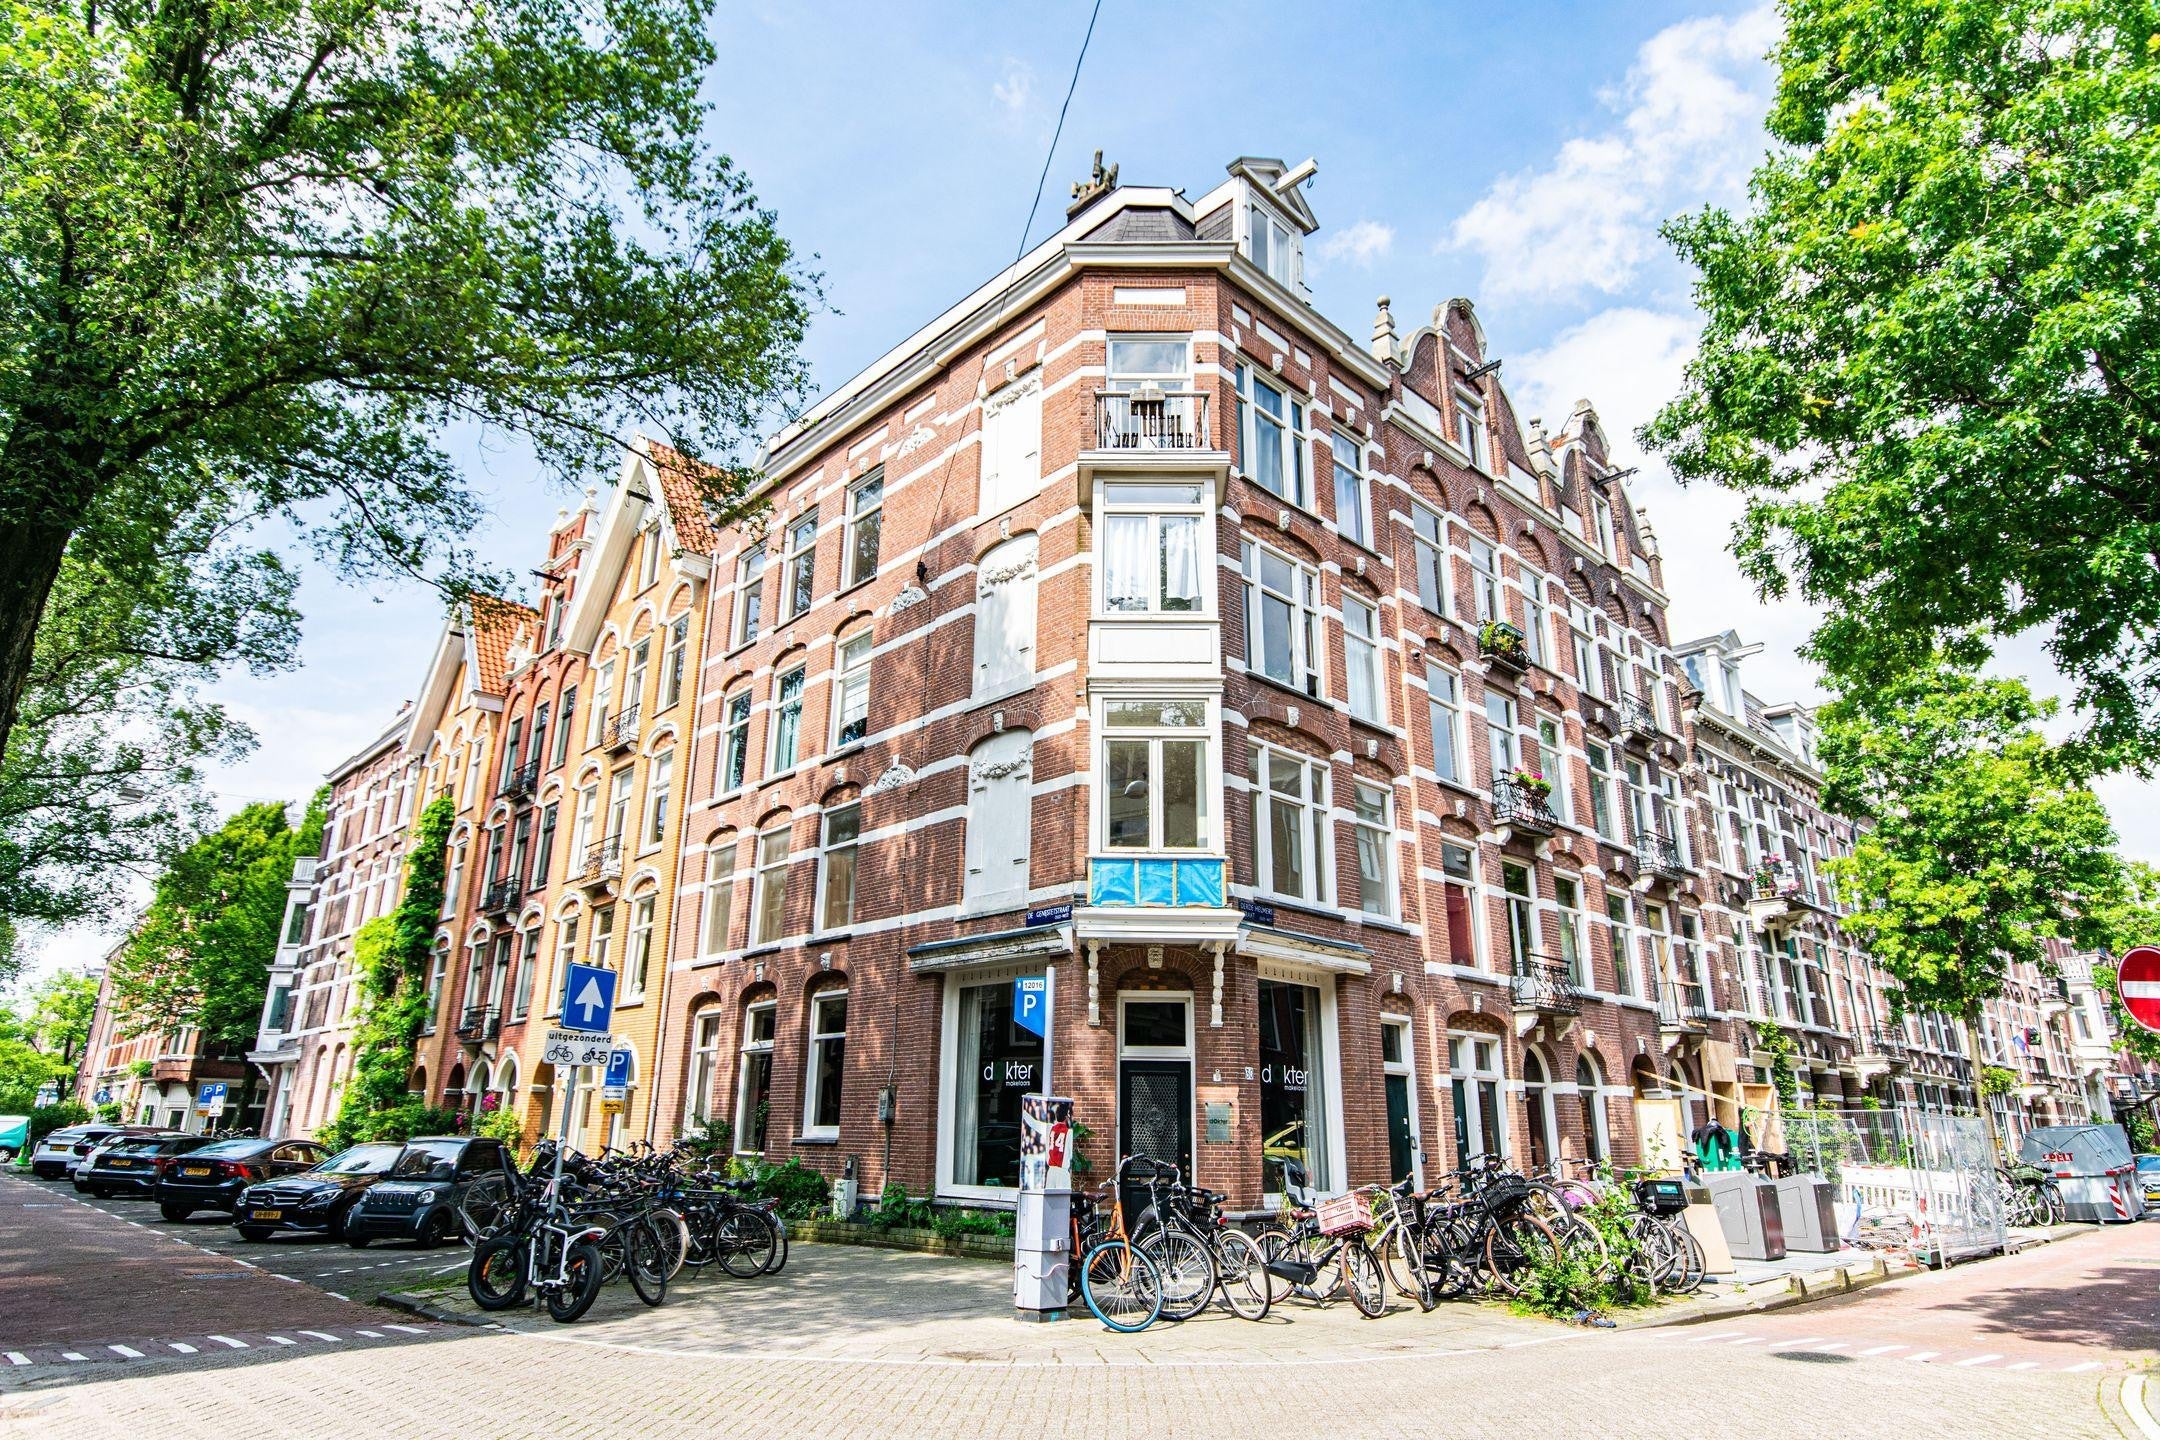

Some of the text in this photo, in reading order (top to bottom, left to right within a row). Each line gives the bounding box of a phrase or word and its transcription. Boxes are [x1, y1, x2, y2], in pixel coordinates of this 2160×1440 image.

[1023, 994, 1037, 1018] P
[548, 1032, 612, 1044] uitgezonderd
[610, 1053, 625, 1072] P
[215, 1085, 224, 1095] P
[1048, 1130, 1066, 1153] 14
